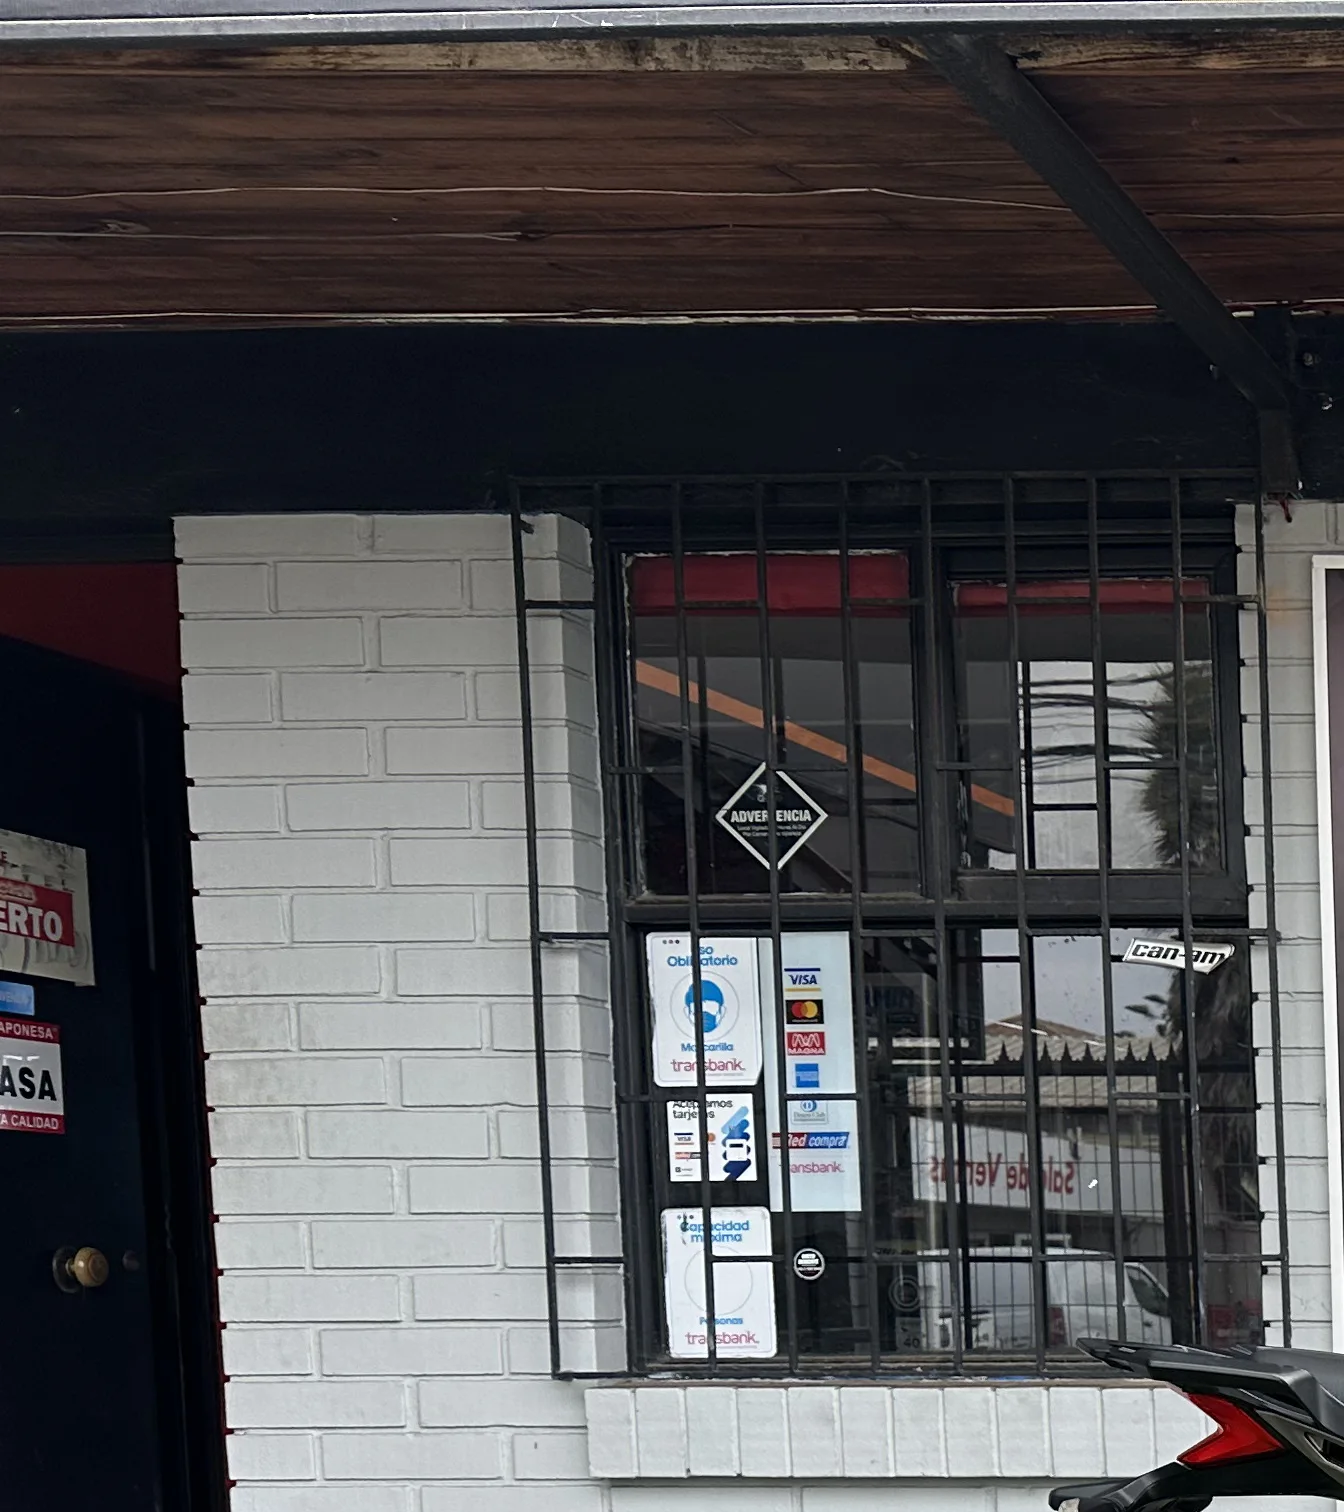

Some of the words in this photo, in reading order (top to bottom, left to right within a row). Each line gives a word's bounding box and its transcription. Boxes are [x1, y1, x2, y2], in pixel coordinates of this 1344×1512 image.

[730, 809, 812, 823] ADVERENCIA
[667, 955, 738, 967] Obliatorio
[789, 974, 818, 985] VISA
[10, 1114, 59, 1130] CALIDAD
[808, 1135, 847, 1148] compra
